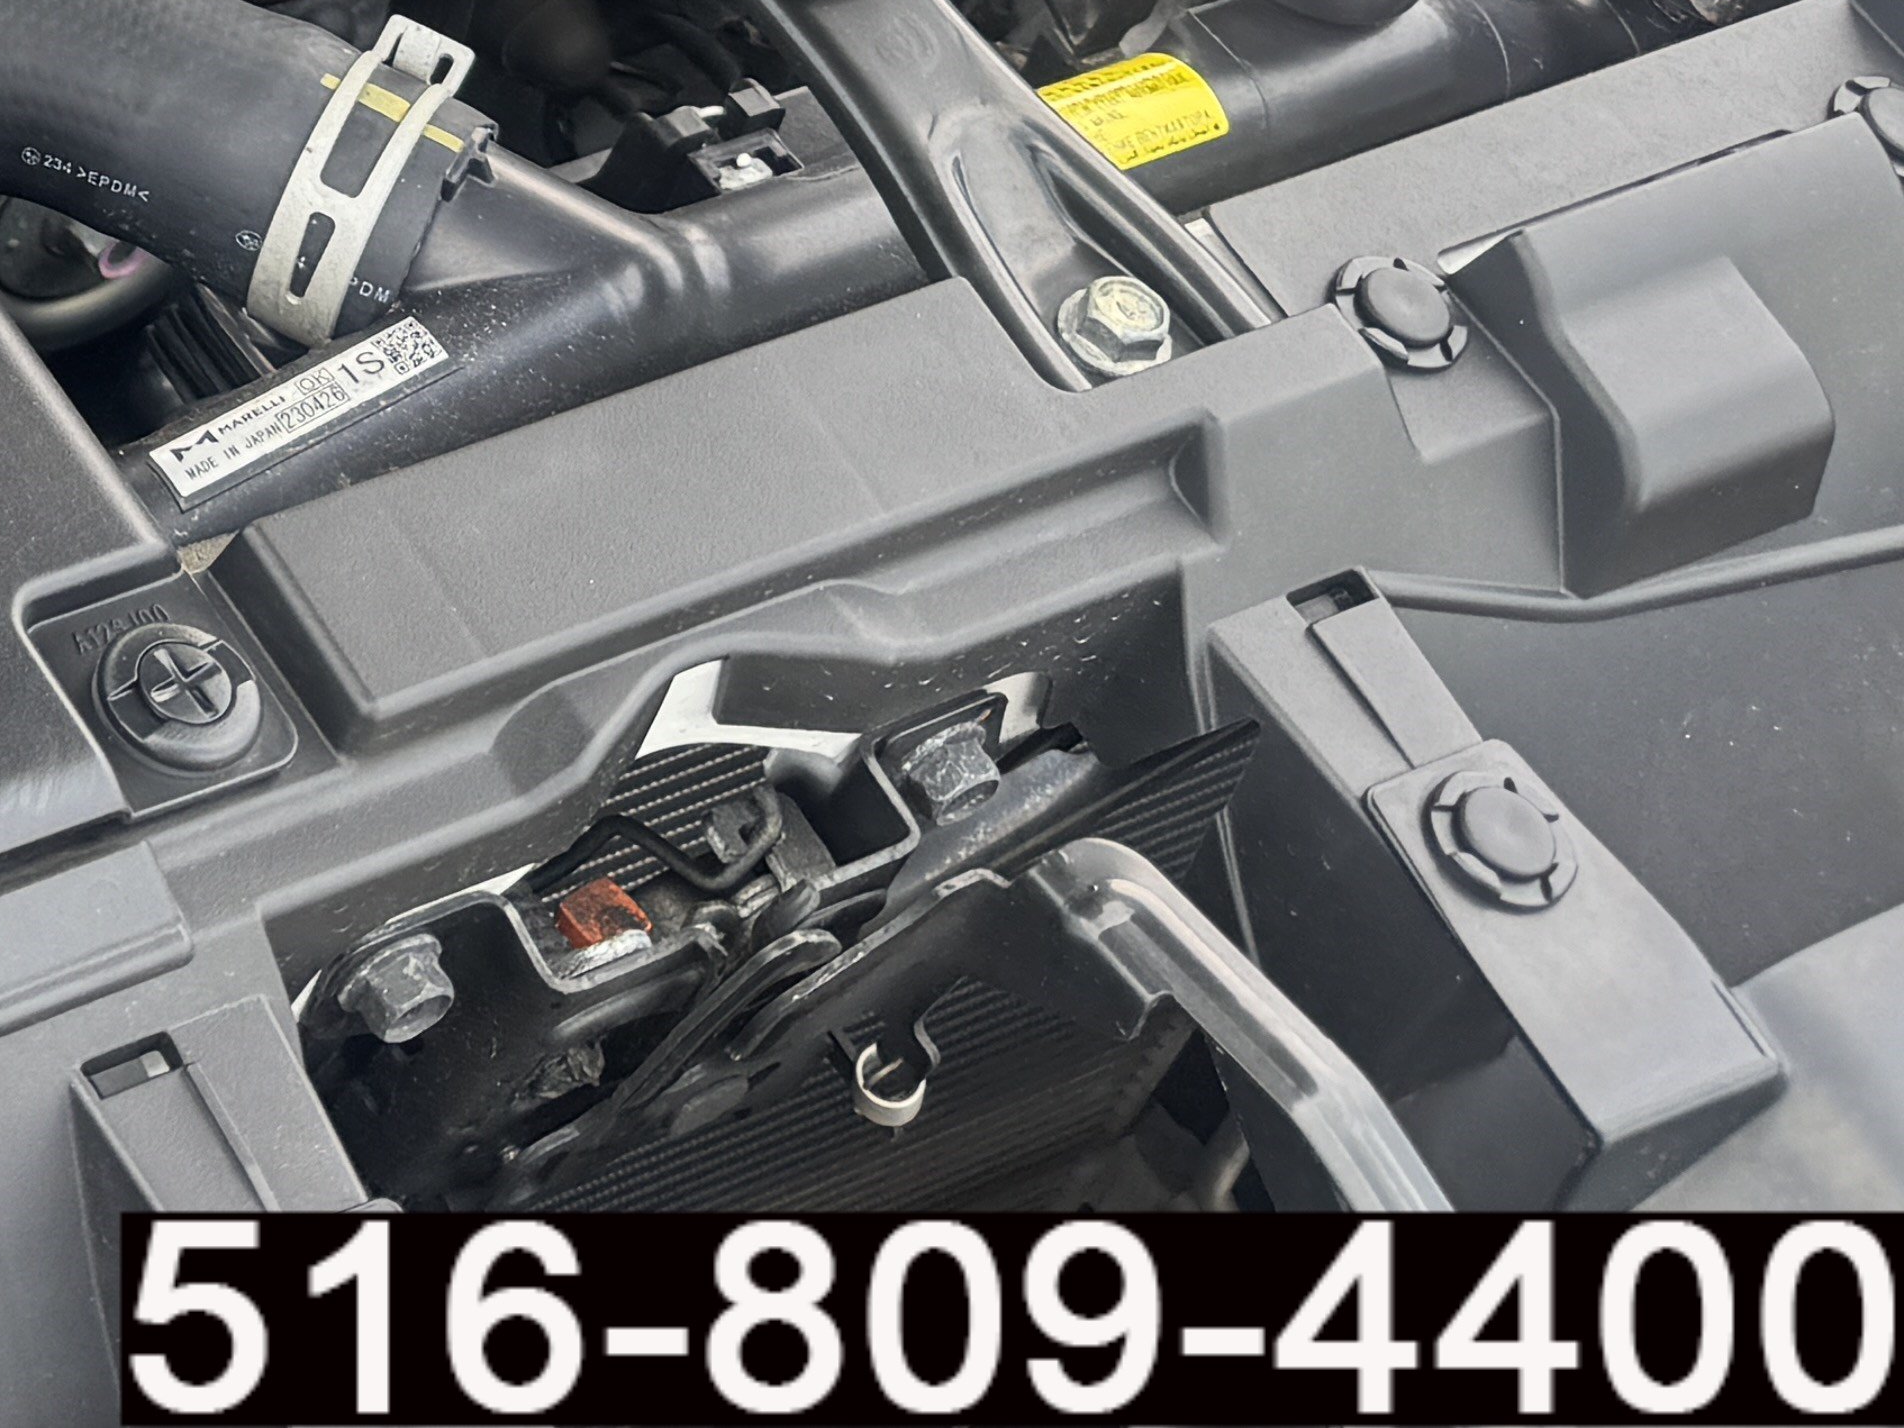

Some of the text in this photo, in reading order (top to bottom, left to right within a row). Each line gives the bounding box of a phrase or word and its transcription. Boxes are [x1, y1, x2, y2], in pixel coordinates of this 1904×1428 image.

[298, 350, 386, 393] OK 1S
[184, 383, 346, 482] MADE IN JAPAN 230426
[217, 395, 287, 436] MARELLI
